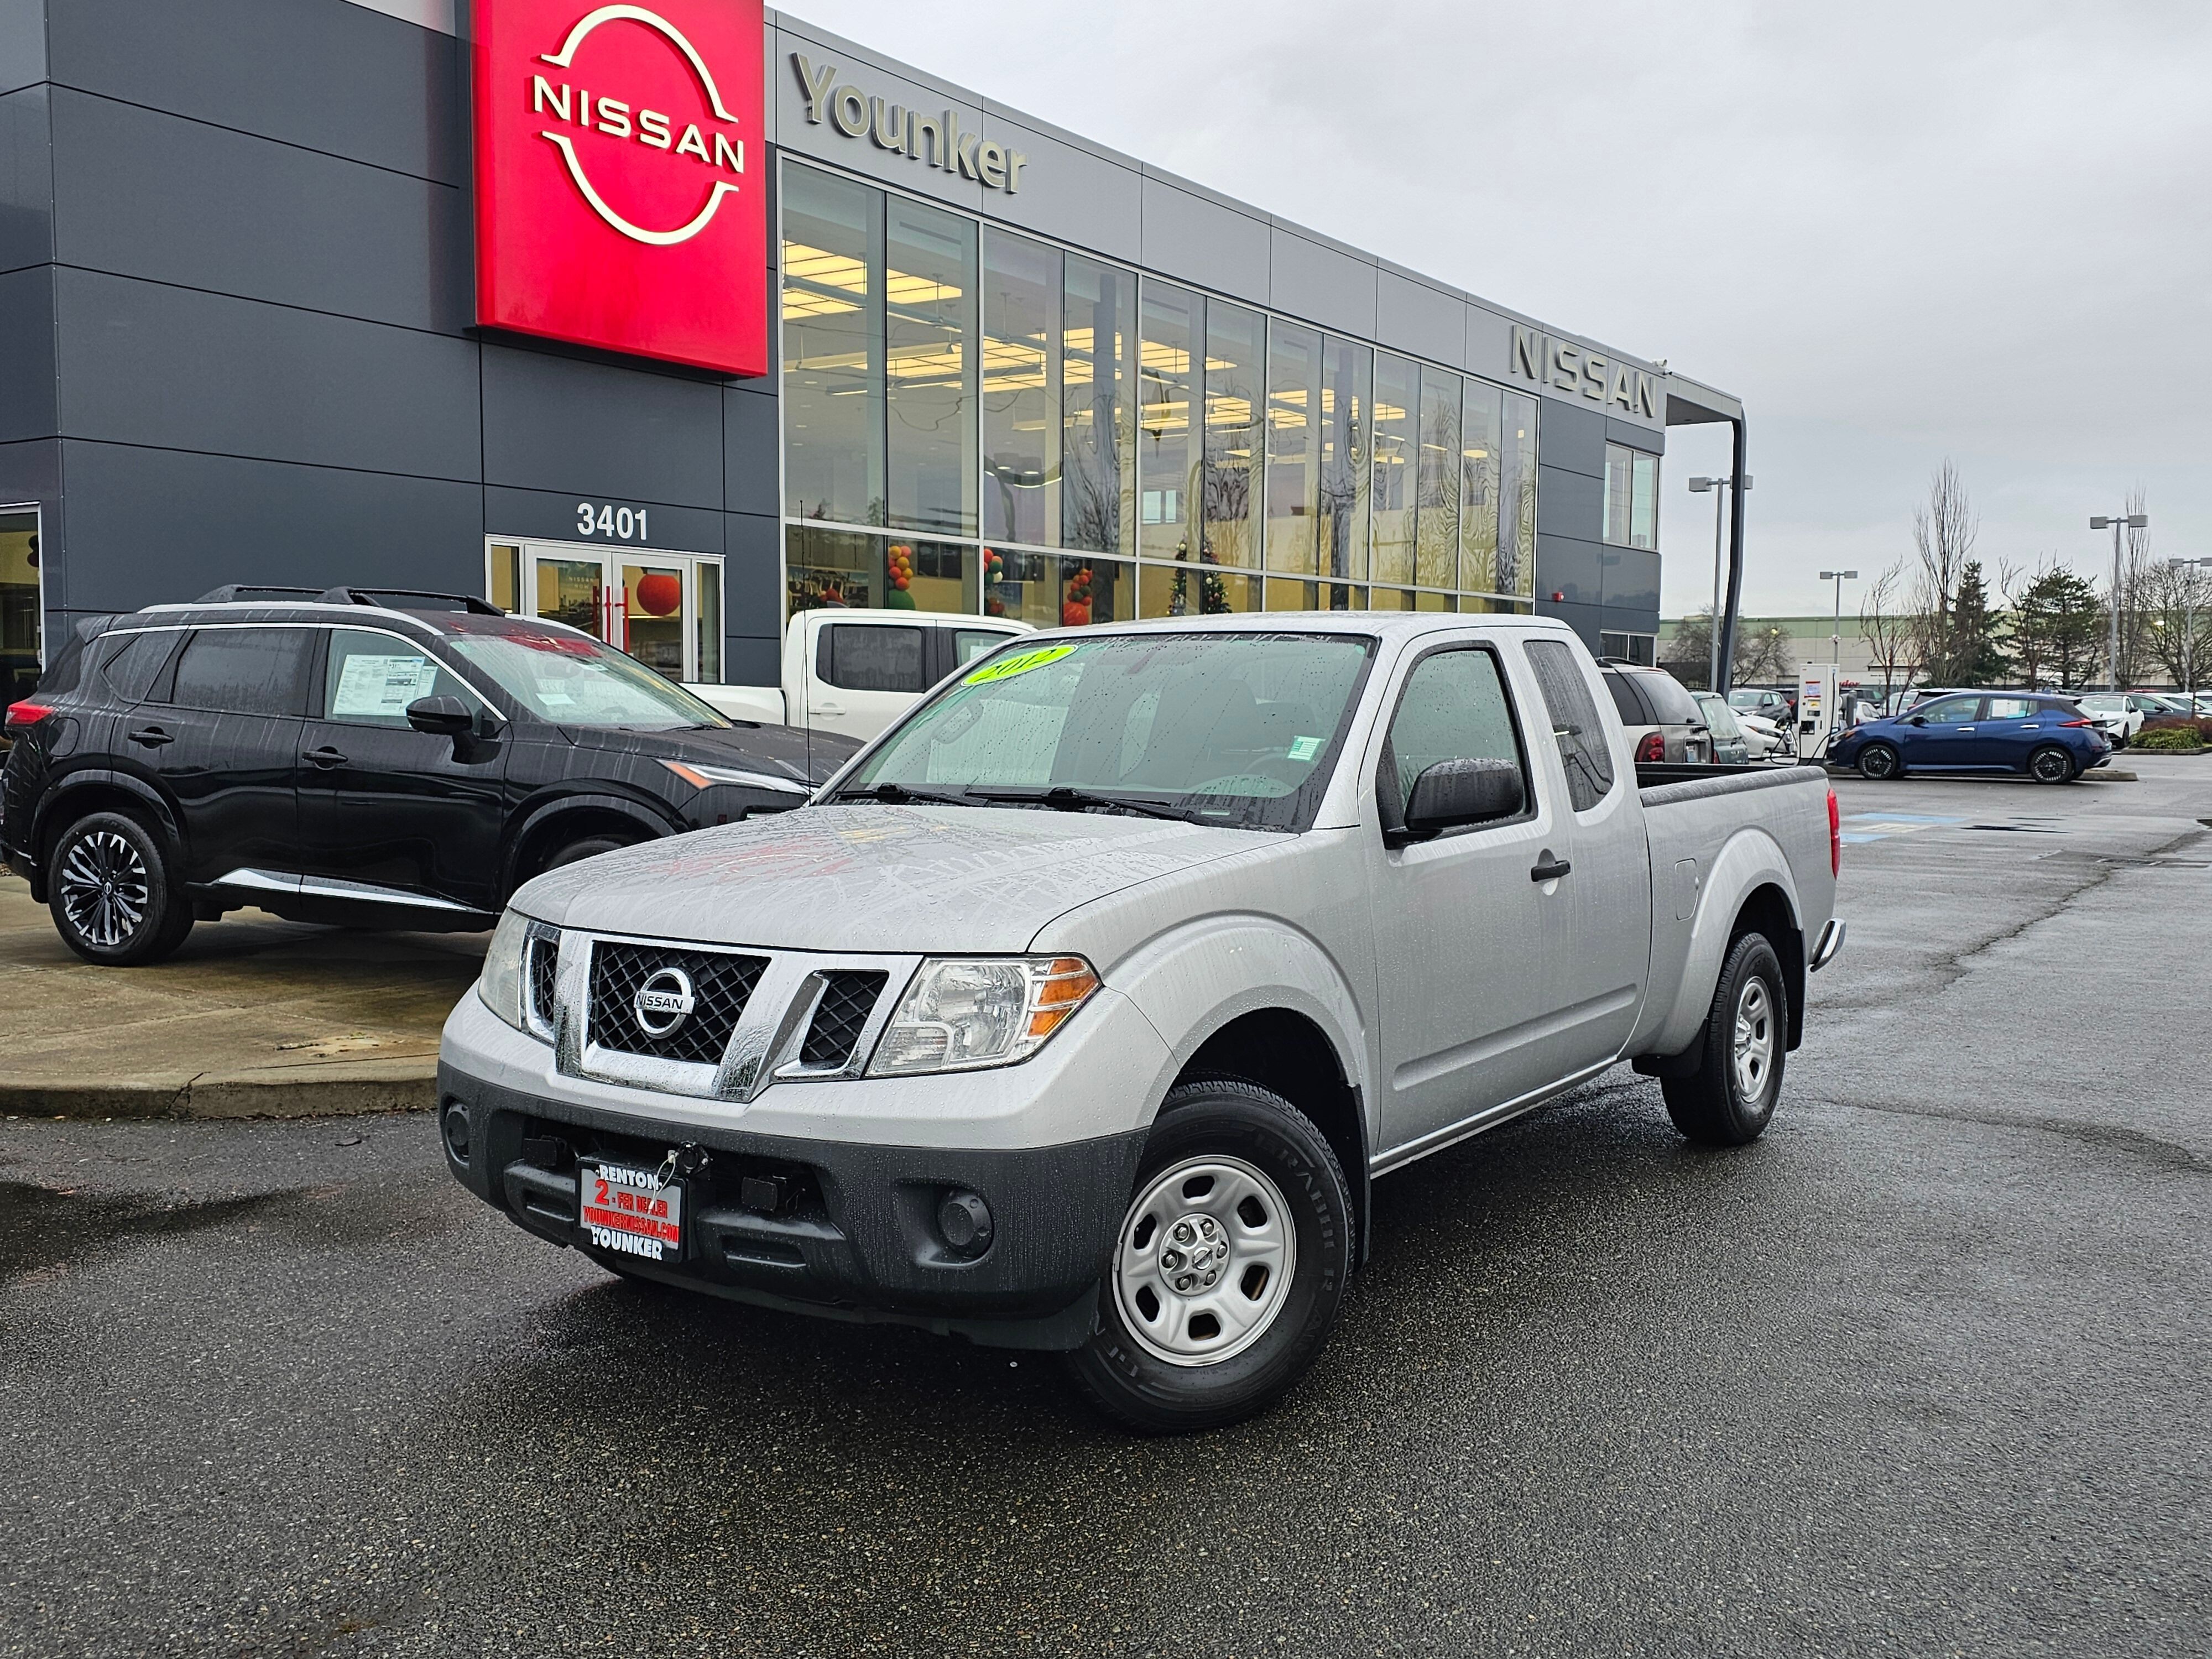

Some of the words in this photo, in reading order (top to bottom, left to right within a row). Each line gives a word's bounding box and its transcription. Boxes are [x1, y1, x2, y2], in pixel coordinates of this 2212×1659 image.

[533, 74, 745, 174] NISSAN
[791, 51, 1027, 194] Younker
[1511, 324, 1656, 418] NISSAN
[577, 502, 646, 540] 3401
[973, 648, 1057, 682] 2012
[636, 994, 684, 1009] NISSAN
[599, 1164, 659, 1190] RENTON
[591, 1225, 662, 1260] YOUNKER
